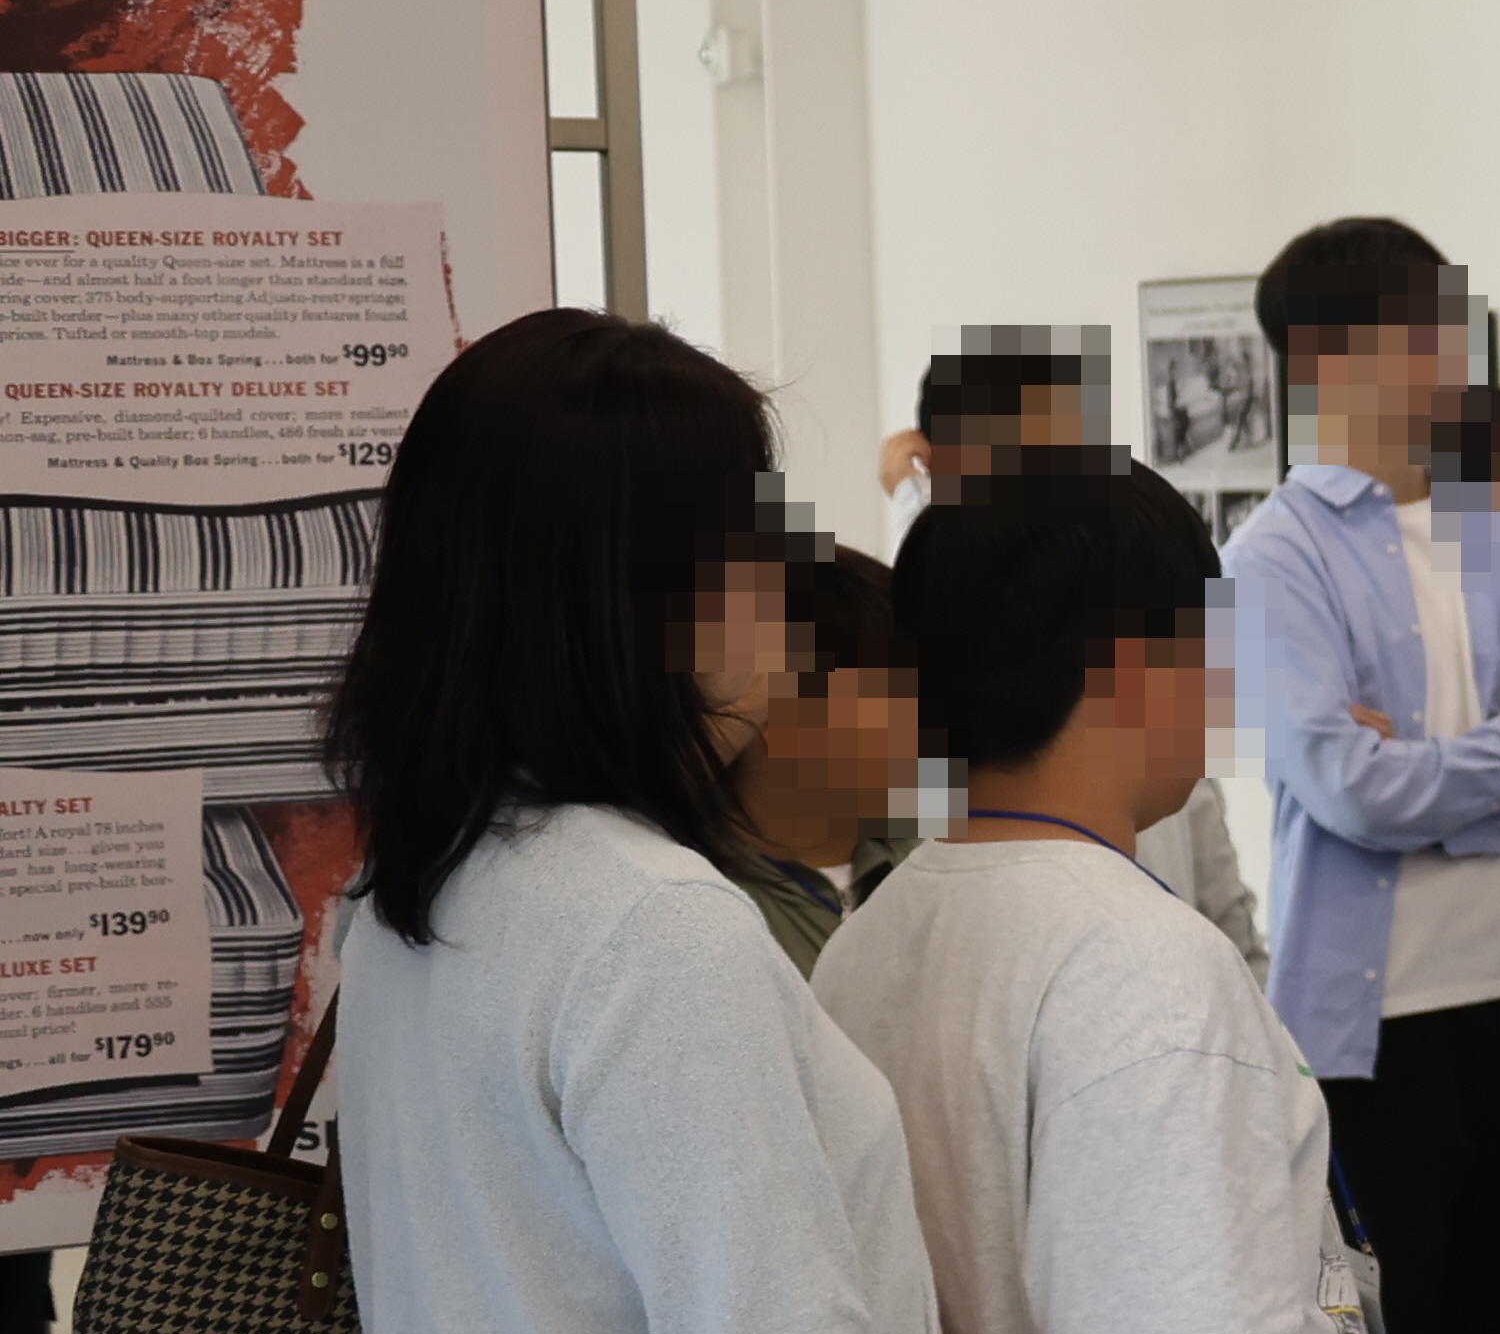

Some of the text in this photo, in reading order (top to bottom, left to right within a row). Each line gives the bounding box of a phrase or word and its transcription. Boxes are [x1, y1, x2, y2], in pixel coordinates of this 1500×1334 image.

[86, 230, 204, 249] QUEEN-SIZE
[212, 231, 299, 247] ROYALTY
[307, 231, 344, 247] SET
[25, 258, 58, 268] ever
[63, 255, 86, 268] for
[102, 255, 159, 271] quality
[280, 255, 347, 269] Mattress
[76, 273, 130, 286] almost
[134, 273, 165, 286] half
[181, 273, 213, 286] foot
[217, 273, 264, 288] longer
[268, 274, 304, 286] than
[306, 273, 373, 286] standard
[85, 291, 114, 304] 375
[156, 314, 201, 324] many
[202, 310, 244, 322] other
[245, 309, 299, 324] quality
[301, 309, 361, 322] features
[52, 326, 109, 341] Tufted
[112, 331, 128, 341] or
[131, 327, 219, 343] smooth-top
[105, 354, 168, 367] Mattress
[172, 354, 184, 367] &
[187, 354, 214, 367] Box
[320, 353, 339, 366] for
[4, 380, 350, 402] QUEEN-SIZE ROYALTY DELUXE SET
[114, 408, 243, 424] diamond-quilted
[307, 424, 344, 439] fresh
[347, 424, 368, 438] air
[47, 457, 108, 469] Mattress
[114, 456, 125, 468] &
[129, 455, 179, 470] Quality
[183, 454, 209, 467] Box
[315, 452, 335, 465] for
[54, 796, 93, 815] SET
[51, 822, 92, 841] royal
[60, 955, 98, 975] SET
[110, 998, 141, 1013] and
